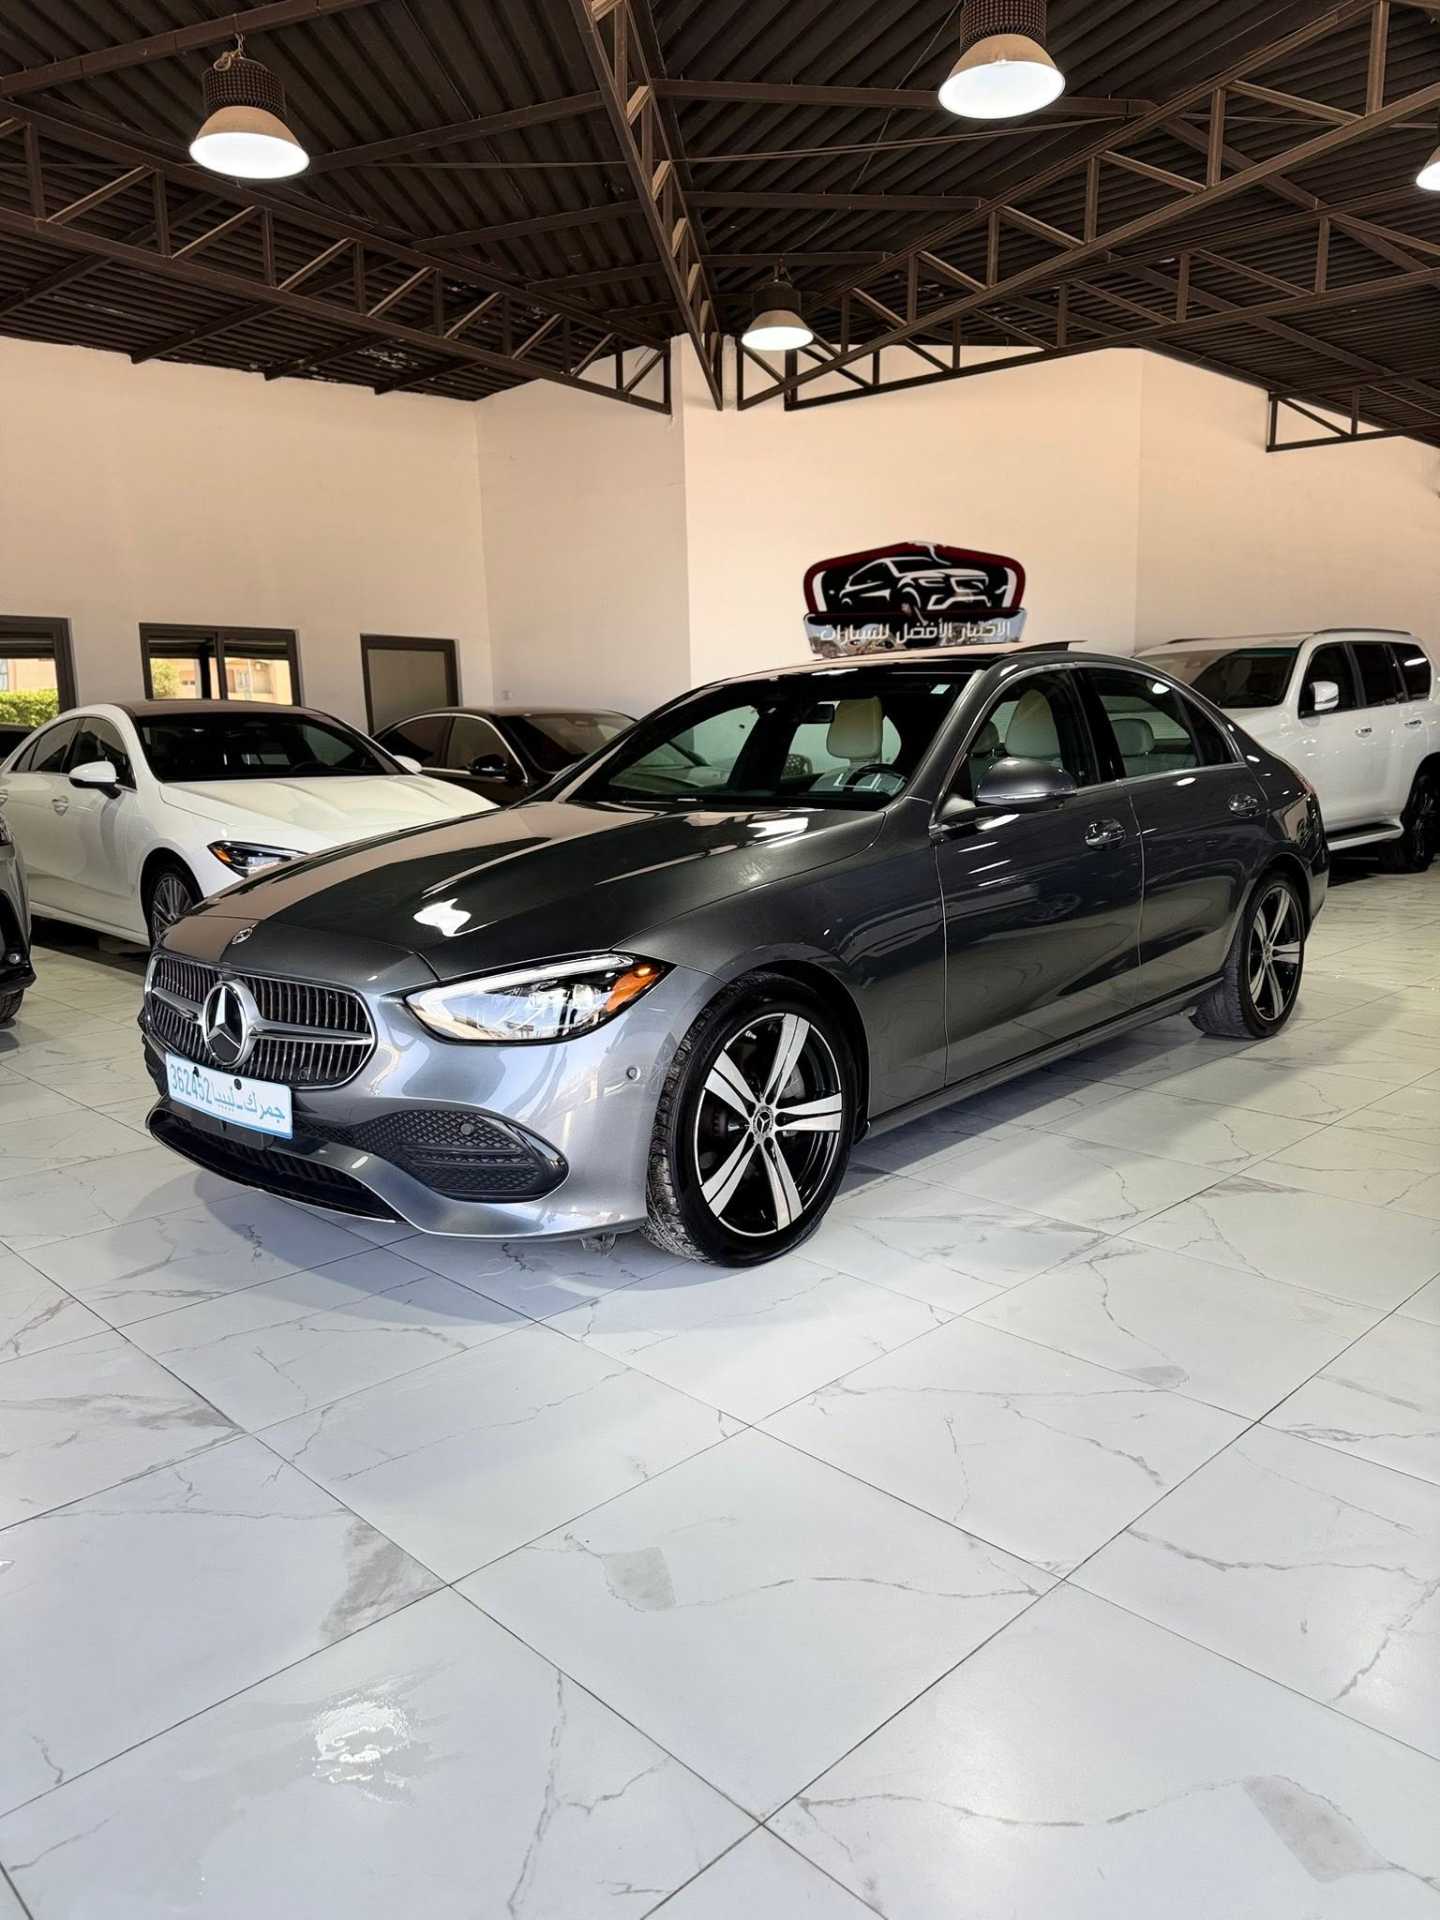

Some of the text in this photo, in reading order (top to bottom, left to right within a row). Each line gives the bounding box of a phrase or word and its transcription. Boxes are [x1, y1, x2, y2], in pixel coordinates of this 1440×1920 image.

[819, 617, 1011, 645] الاختيار الأفضل للسيارات
